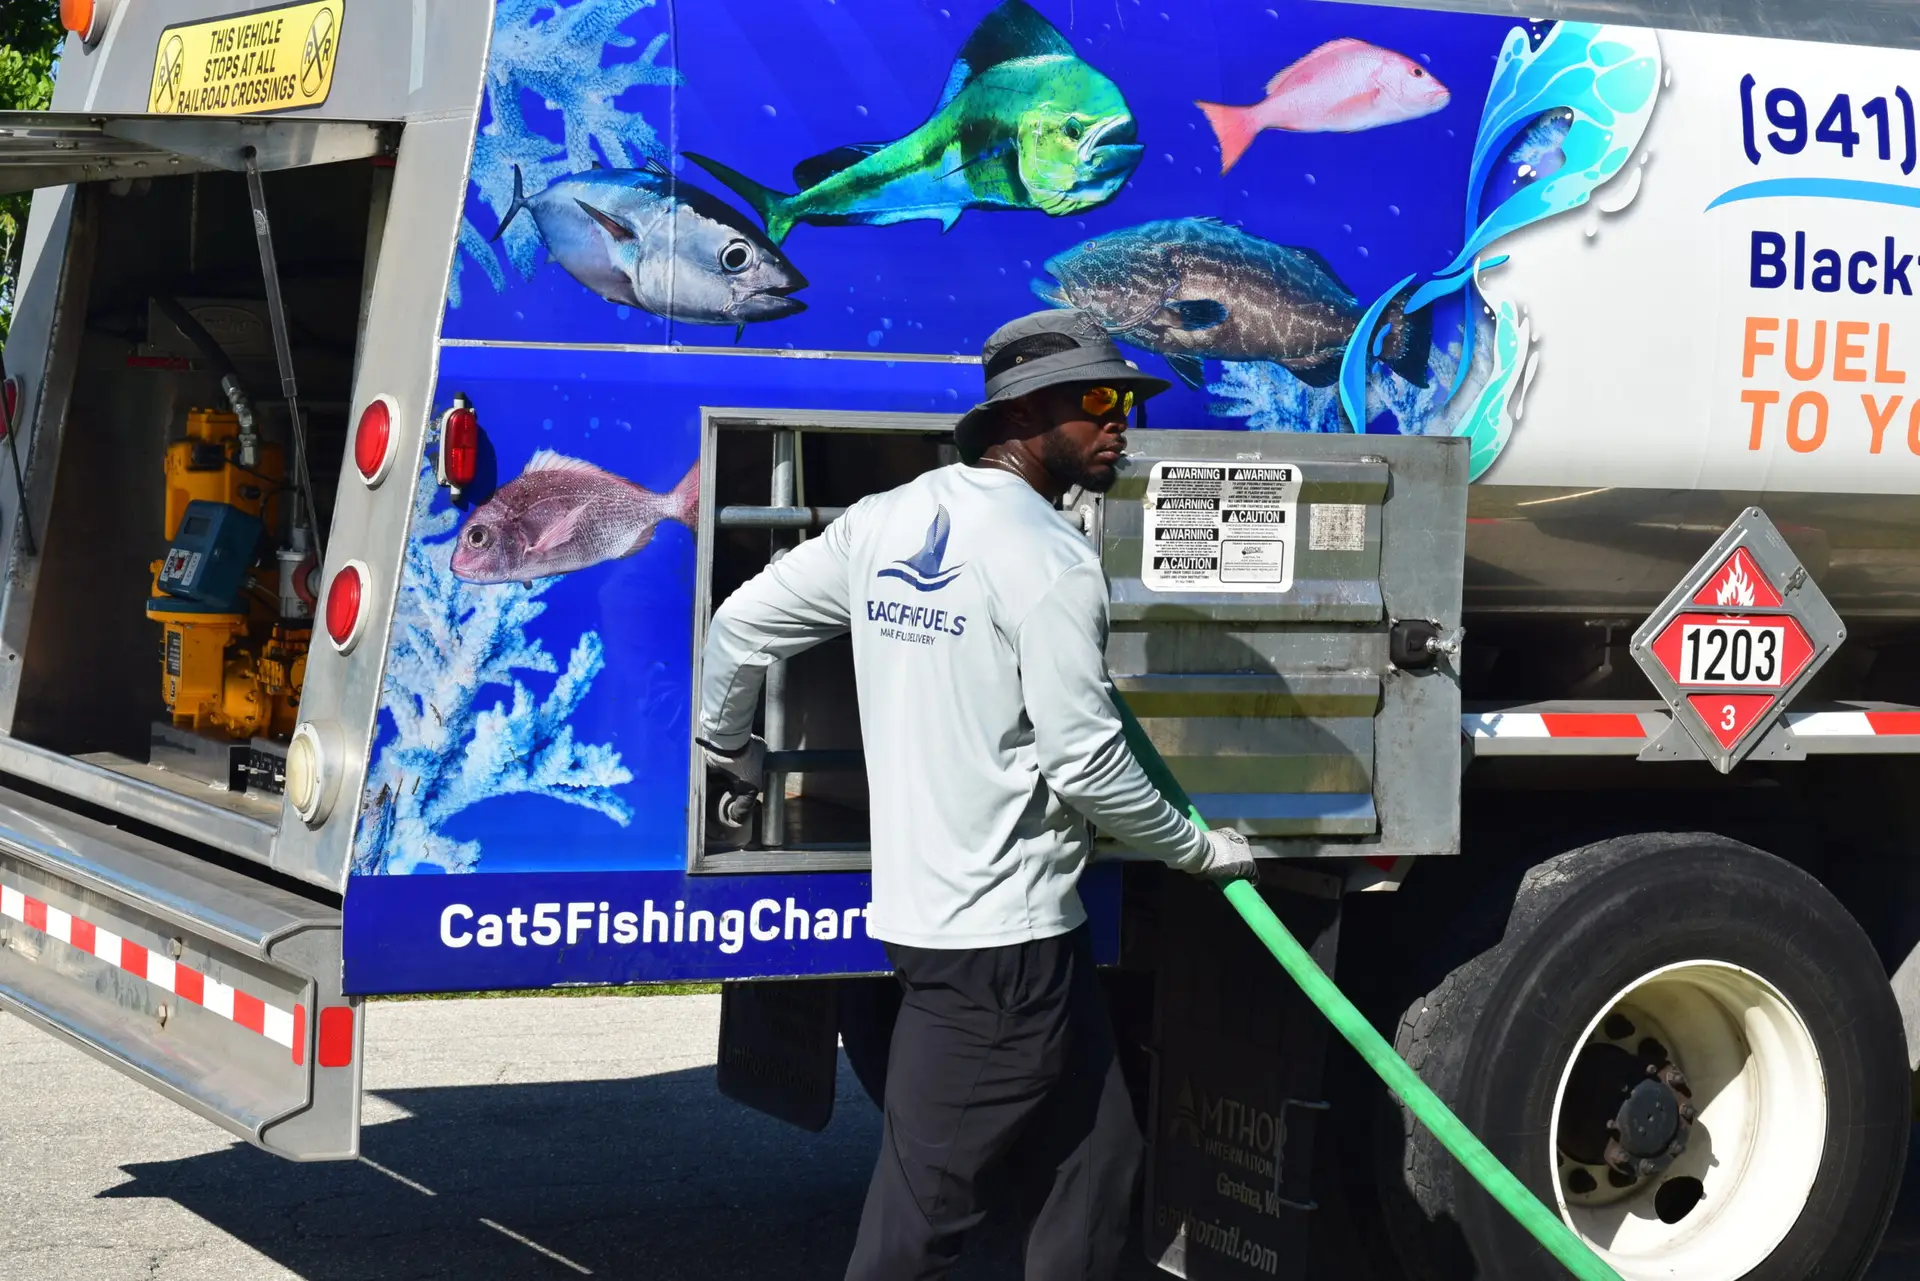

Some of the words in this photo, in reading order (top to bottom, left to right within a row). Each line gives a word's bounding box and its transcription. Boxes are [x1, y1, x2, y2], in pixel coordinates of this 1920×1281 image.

[209, 27, 235, 54] THIS
[236, 19, 283, 50] VEHICLE
[203, 56, 239, 83] STOPS
[239, 52, 257, 78] AT
[256, 49, 276, 74] ALL
[177, 82, 230, 113] RAILROAD
[230, 74, 296, 107] CROSSINGS
[1740, 73, 1917, 175] (941)
[1749, 230, 1920, 296] Black
[1742, 316, 1906, 384] FUEL
[1740, 389, 1829, 454] TO
[1176, 468, 1220, 480] WARNING
[1243, 469, 1286, 481] WARNING
[1170, 498, 1214, 510] WARNING
[1239, 511, 1280, 523] CAUTION
[1170, 528, 1213, 540] WARNING
[1170, 557, 1212, 569] CAUTION
[1686, 628, 1776, 682] 1203
[1720, 704, 1736, 731] 3
[1205, 1137, 1284, 1184] INTERNATIONL
